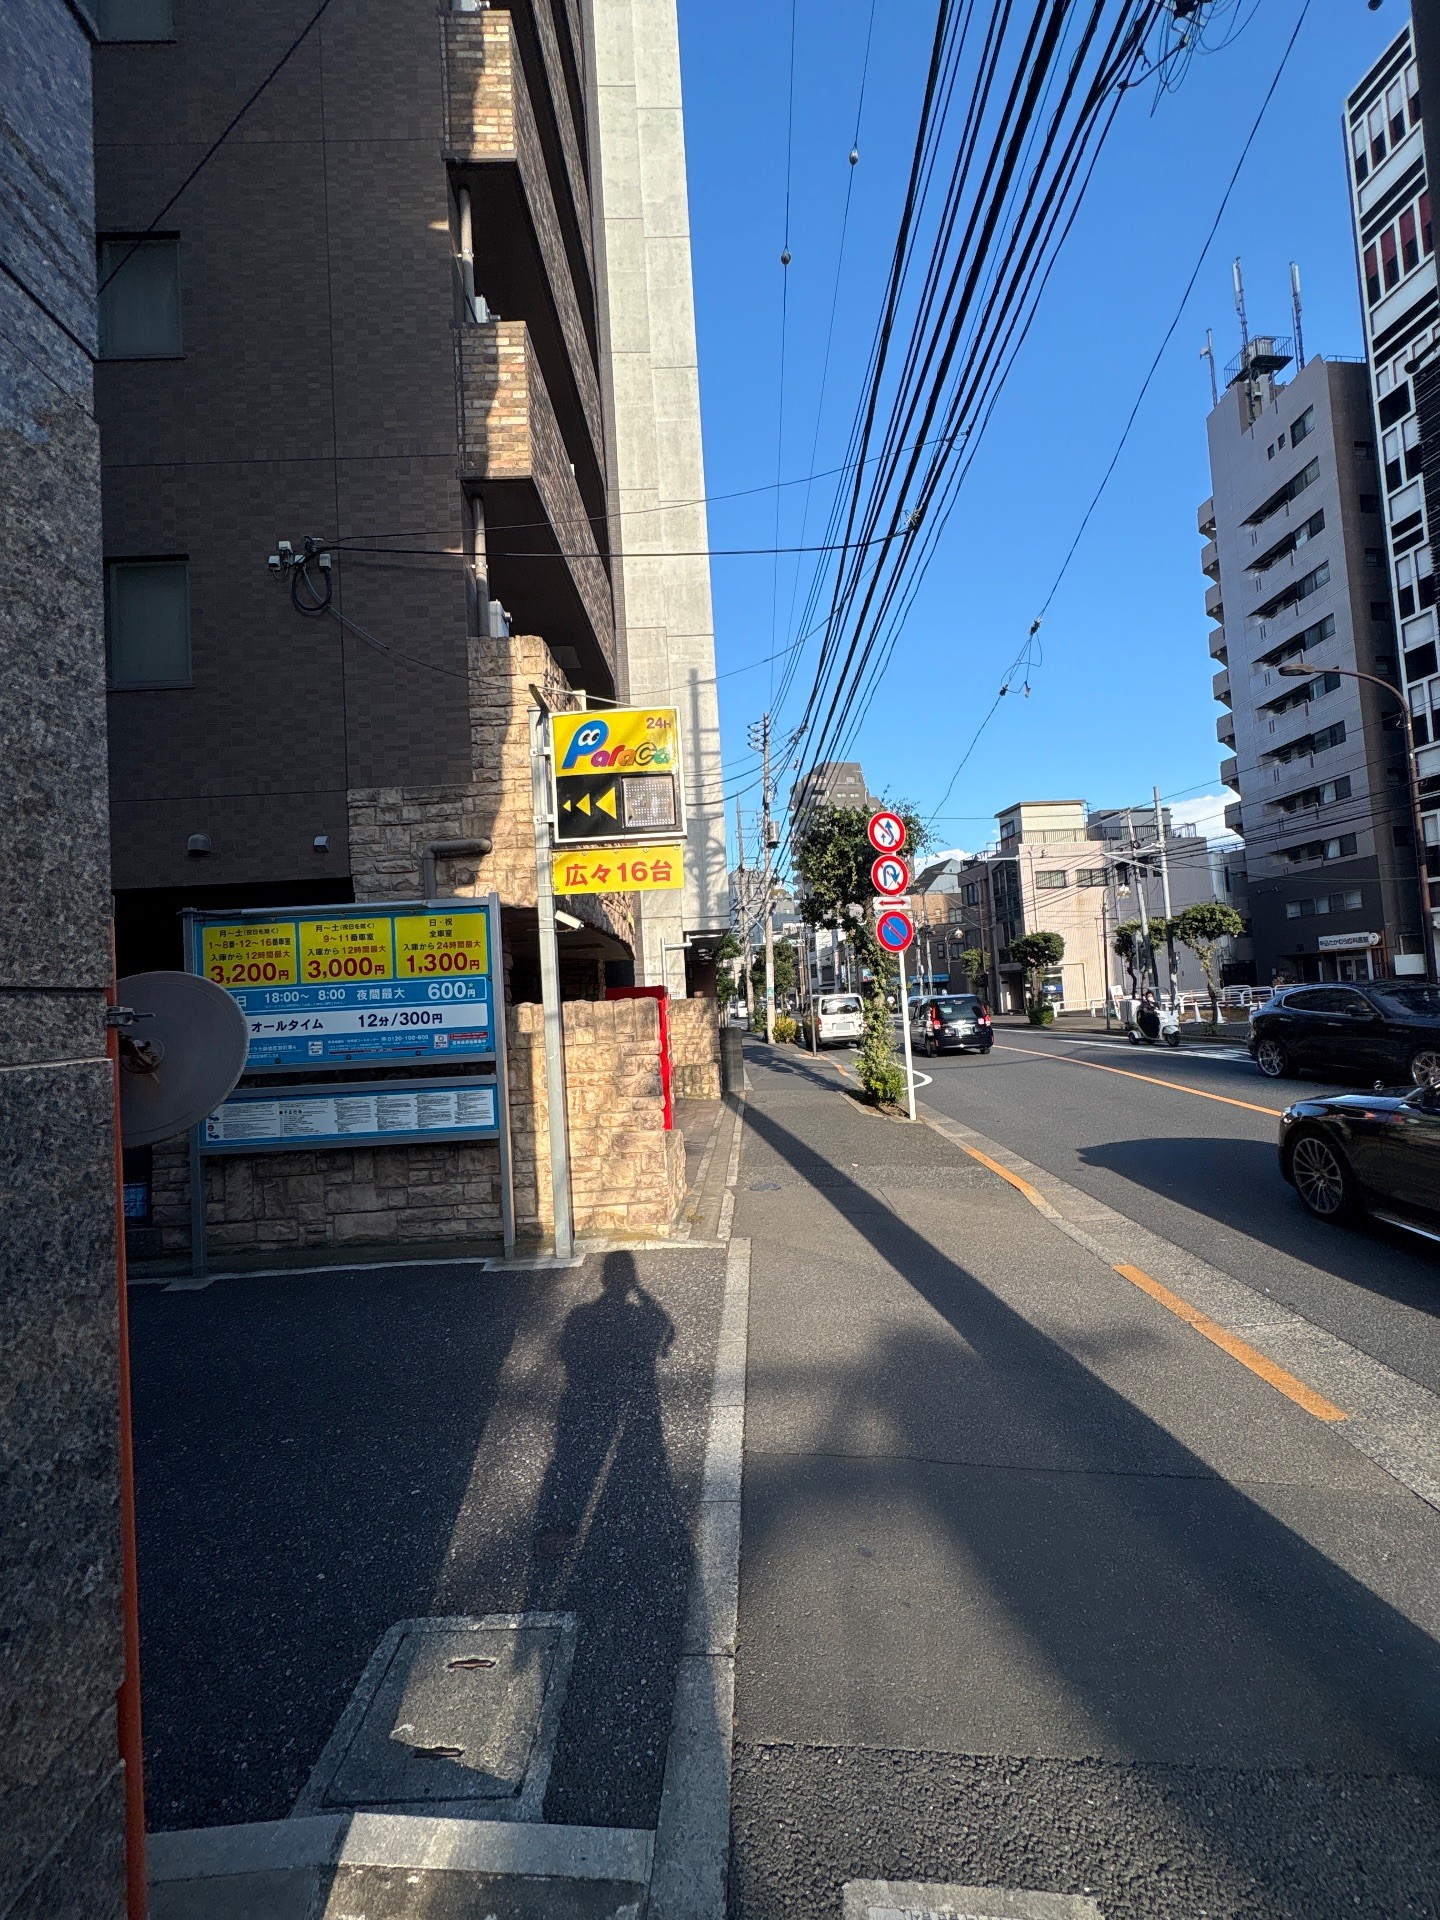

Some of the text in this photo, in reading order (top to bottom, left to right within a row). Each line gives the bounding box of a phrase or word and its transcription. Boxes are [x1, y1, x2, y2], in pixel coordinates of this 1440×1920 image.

[645, 718, 672, 731] 24H
[564, 859, 673, 887] 広々16台
[210, 962, 289, 984] 3,200円
[308, 957, 385, 979] 3,000円
[406, 952, 480, 973] 1,300円
[356, 987, 406, 1001] 夜間最大
[427, 981, 476, 1000] 600円
[251, 1011, 443, 1032] オールタイム 12分/300円
